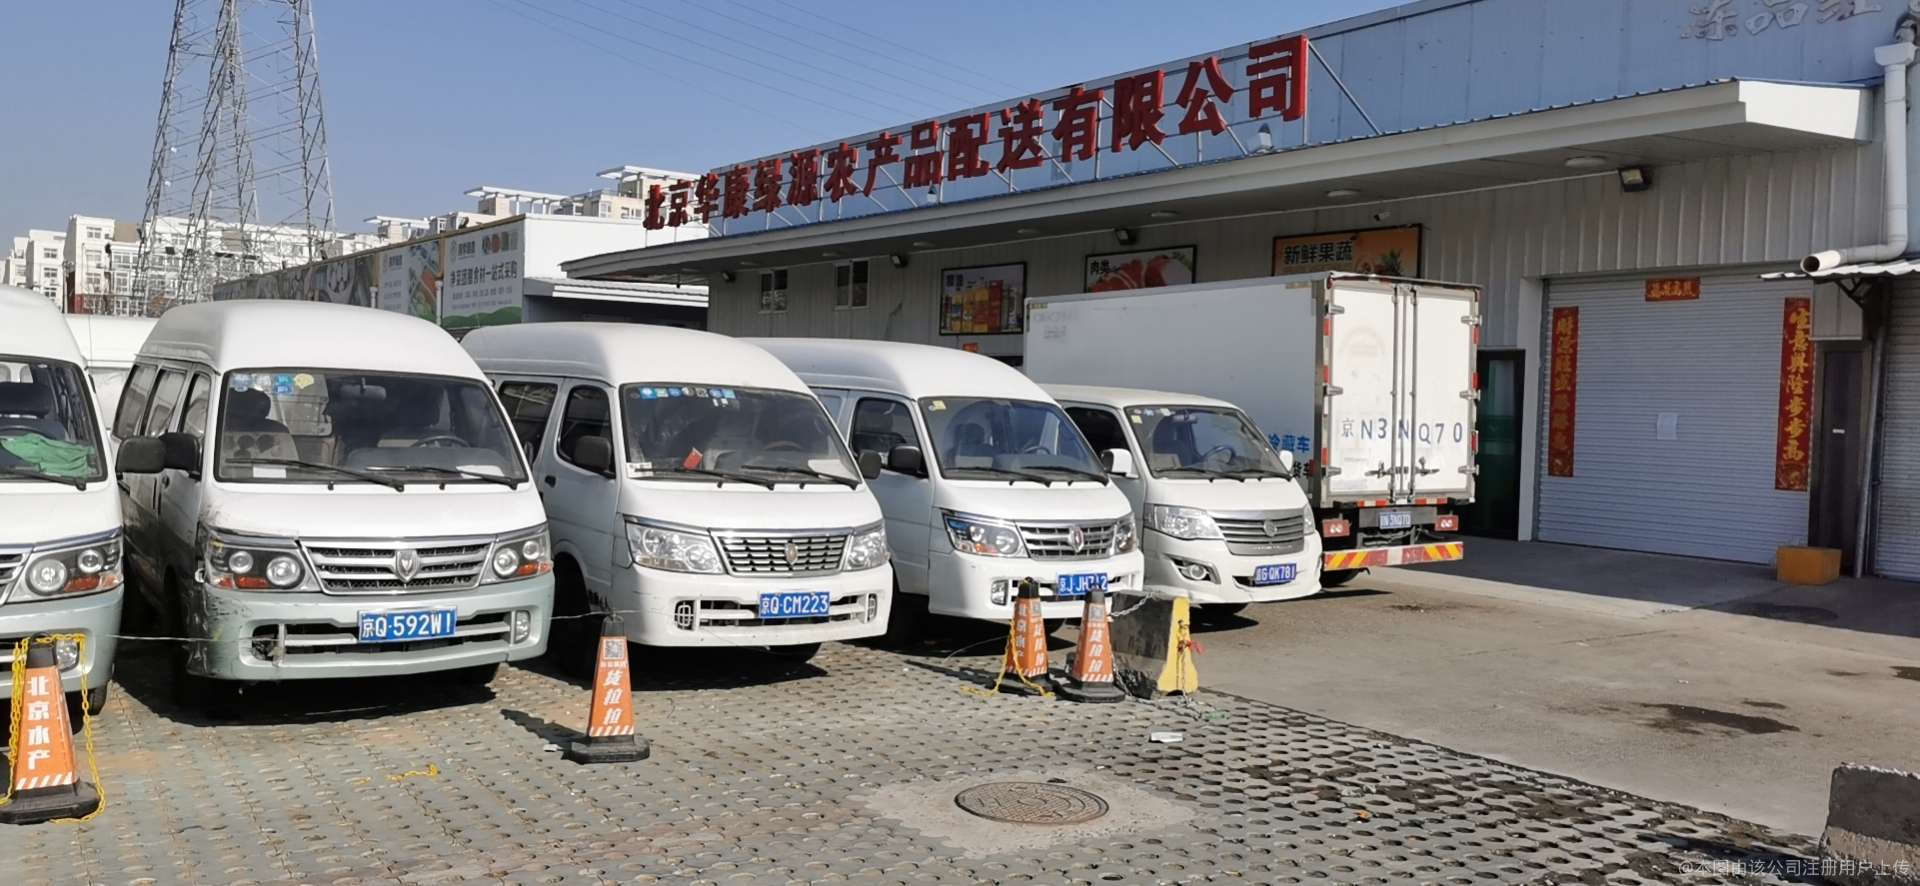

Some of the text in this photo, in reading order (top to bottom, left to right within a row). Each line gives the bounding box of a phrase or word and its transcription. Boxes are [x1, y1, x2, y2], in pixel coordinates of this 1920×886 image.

[643, 34, 1309, 230] 北京华康绿源农产品配送有限公司
[1284, 240, 1353, 264] 新鲜果蔬
[27, 676, 50, 770] 北京水产
